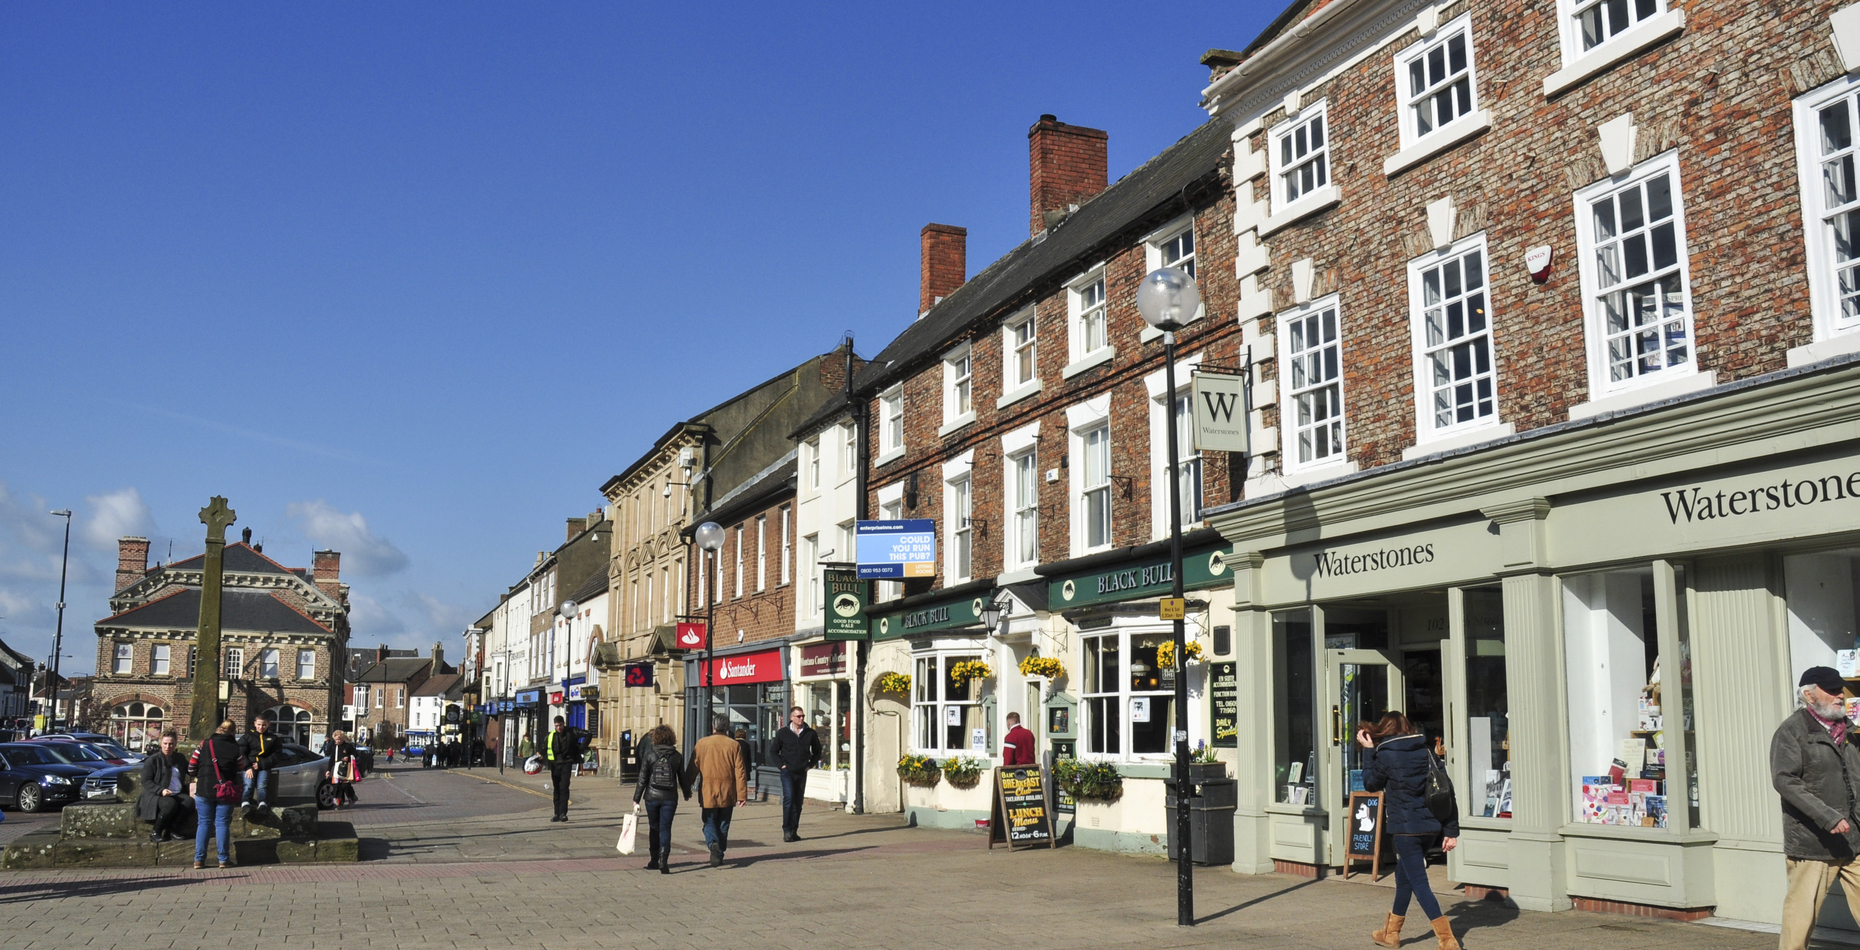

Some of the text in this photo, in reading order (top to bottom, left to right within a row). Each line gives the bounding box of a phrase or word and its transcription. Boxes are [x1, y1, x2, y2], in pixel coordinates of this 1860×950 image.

[1527, 251, 1546, 262] KINGS
[1200, 391, 1239, 423] W
[1202, 427, 1239, 435] Waterstones
[900, 536, 930, 544] COULD
[912, 544, 930, 552] RUN
[909, 552, 931, 560] PUB?
[1313, 542, 1435, 579] Waterstones
[1097, 562, 1173, 593] BLACK BULL
[831, 583, 862, 595] BULL
[905, 607, 949, 628] BLACK BULL
[814, 655, 829, 666] Country
[727, 657, 756, 678] Santander
[1002, 777, 1040, 789] BREAKFAST
[1015, 786, 1032, 797] Club
[1367, 798, 1378, 807] DOG
[1008, 806, 1044, 819] LUNCH
[1012, 817, 1039, 827] Menu
[1353, 834, 1373, 843] FRIENDLY
[1354, 842, 1369, 851] STORE
